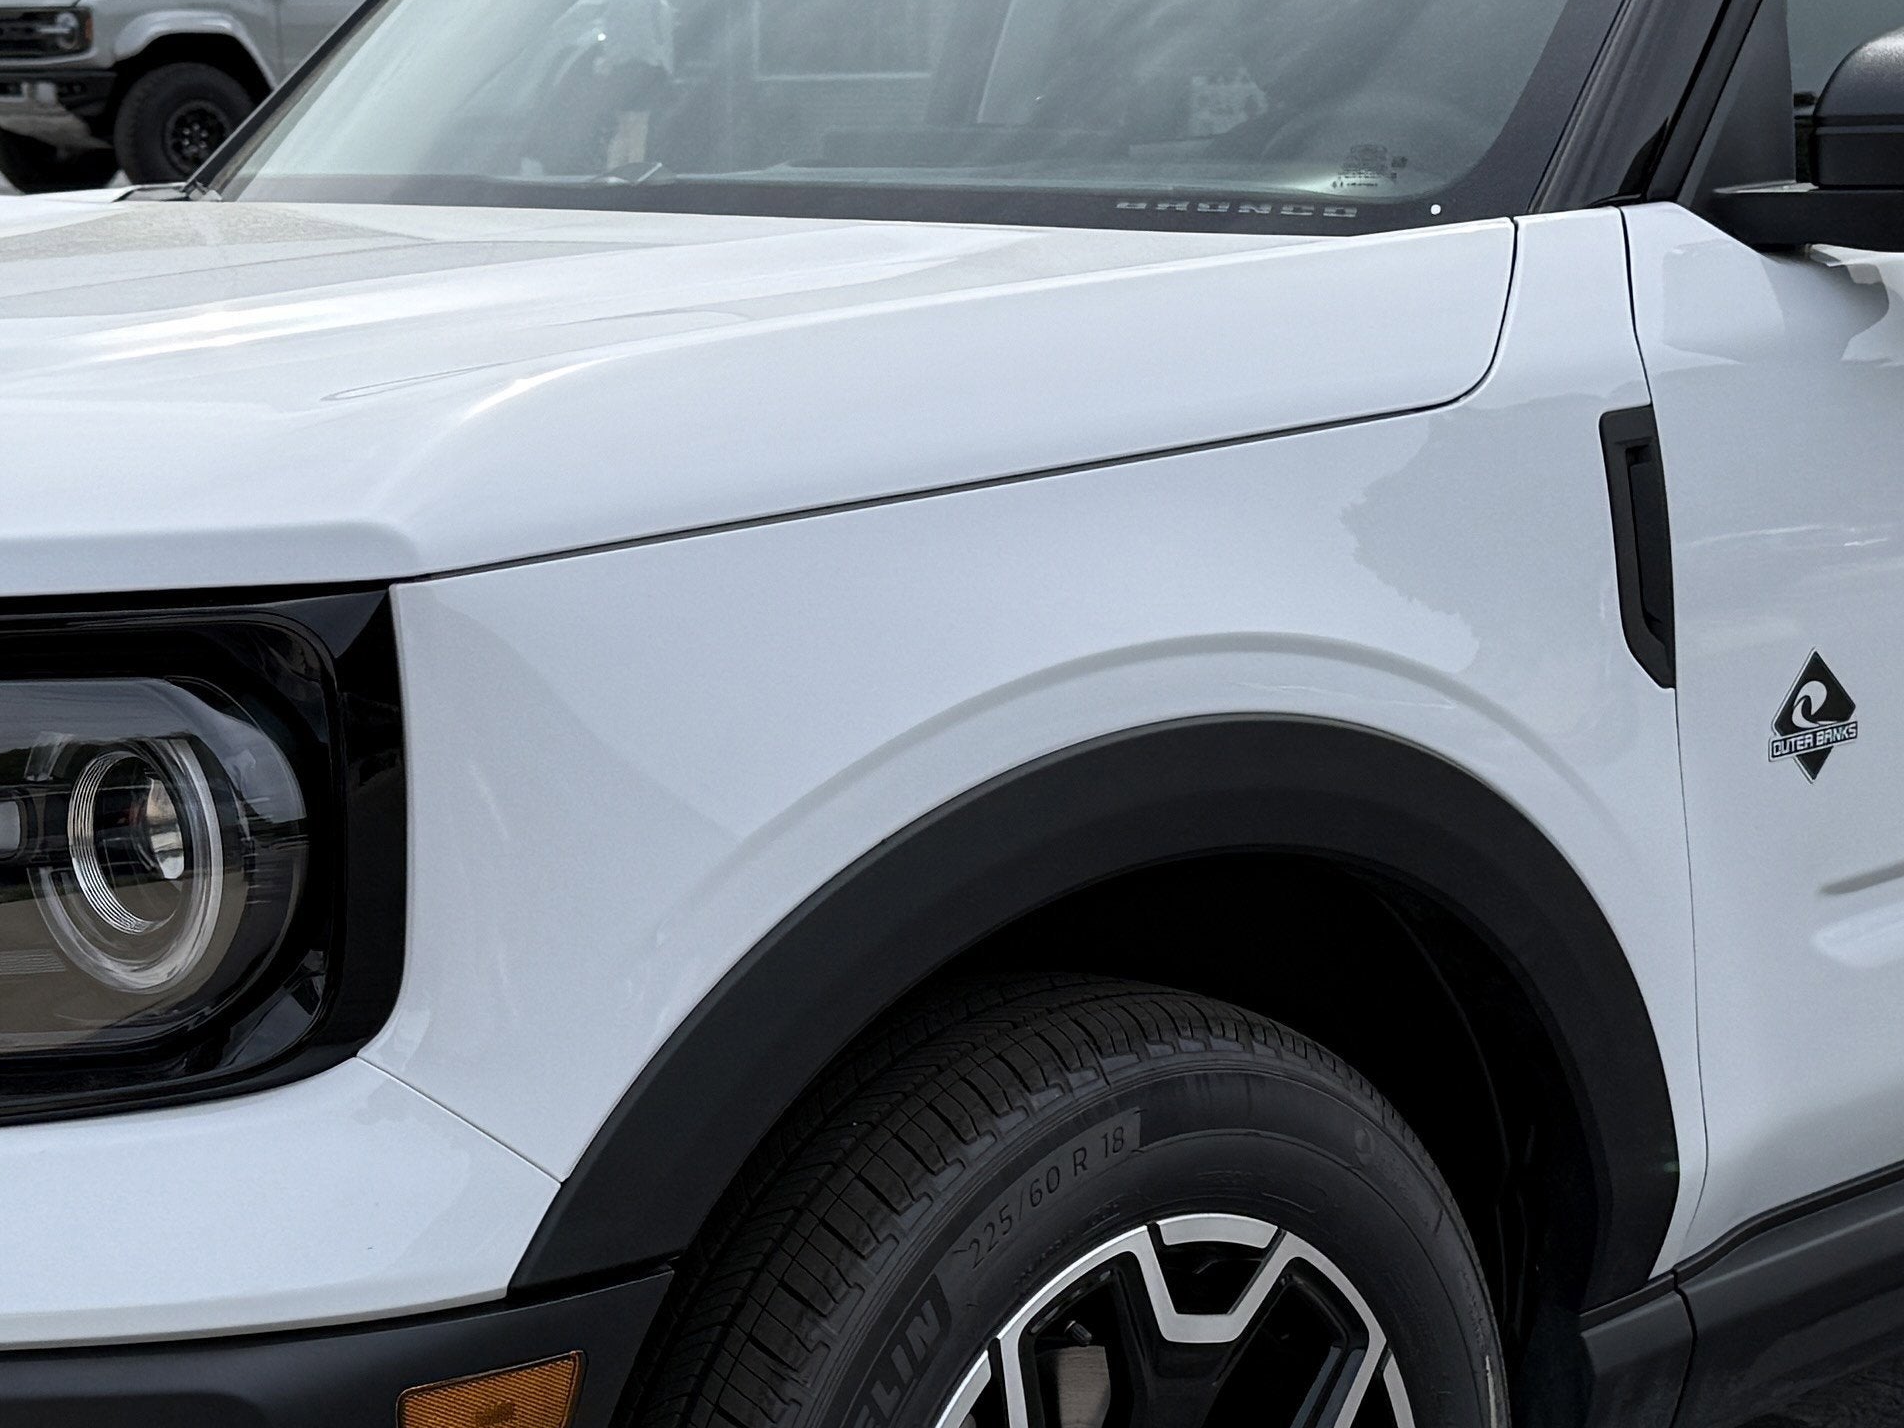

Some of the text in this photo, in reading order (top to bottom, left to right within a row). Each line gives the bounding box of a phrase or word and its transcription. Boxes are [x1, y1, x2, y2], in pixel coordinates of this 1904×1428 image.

[1773, 722, 1857, 756] OUTER BANKS
[969, 1160, 1061, 1271] 225/60
[1071, 1150, 1089, 1179] R
[1100, 1125, 1126, 1160] 18
